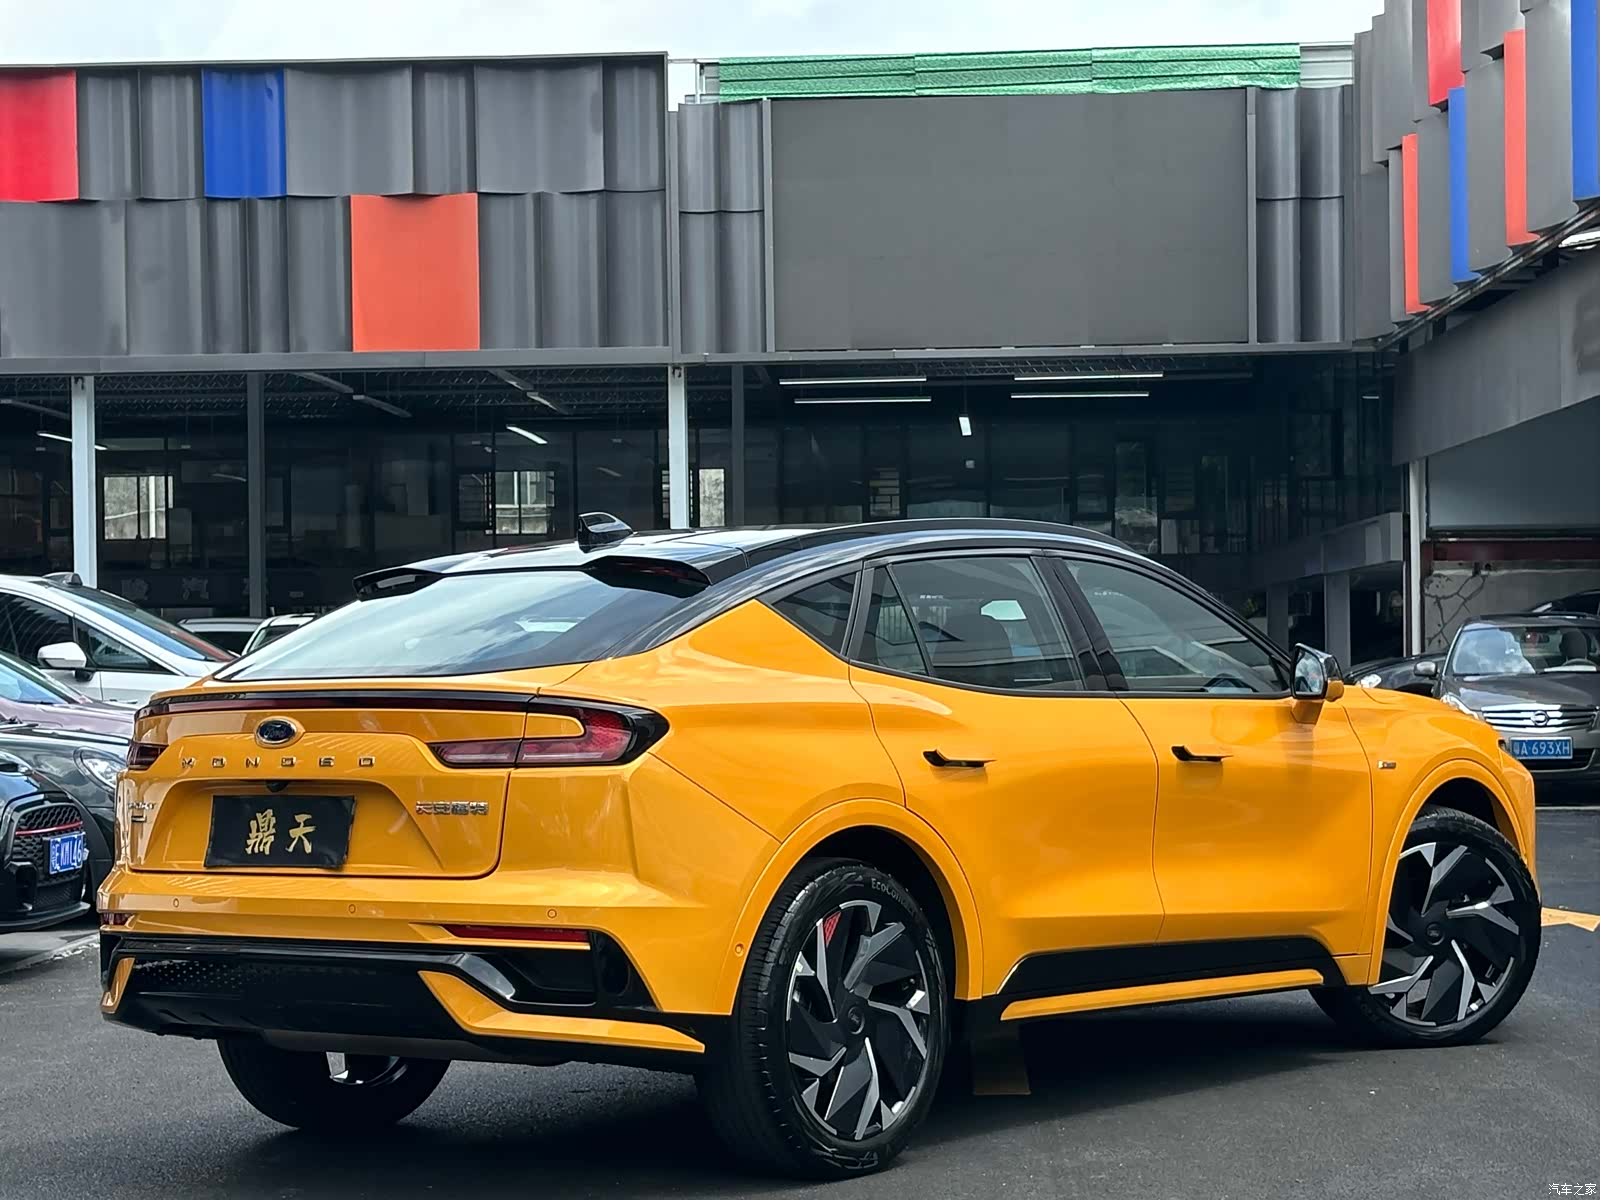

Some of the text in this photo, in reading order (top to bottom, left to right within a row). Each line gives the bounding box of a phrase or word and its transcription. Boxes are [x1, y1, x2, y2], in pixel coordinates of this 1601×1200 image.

[1513, 741, 1570, 756] A·693XH
[180, 756, 377, 769] MONDEO
[245, 808, 317, 855] 鼎天
